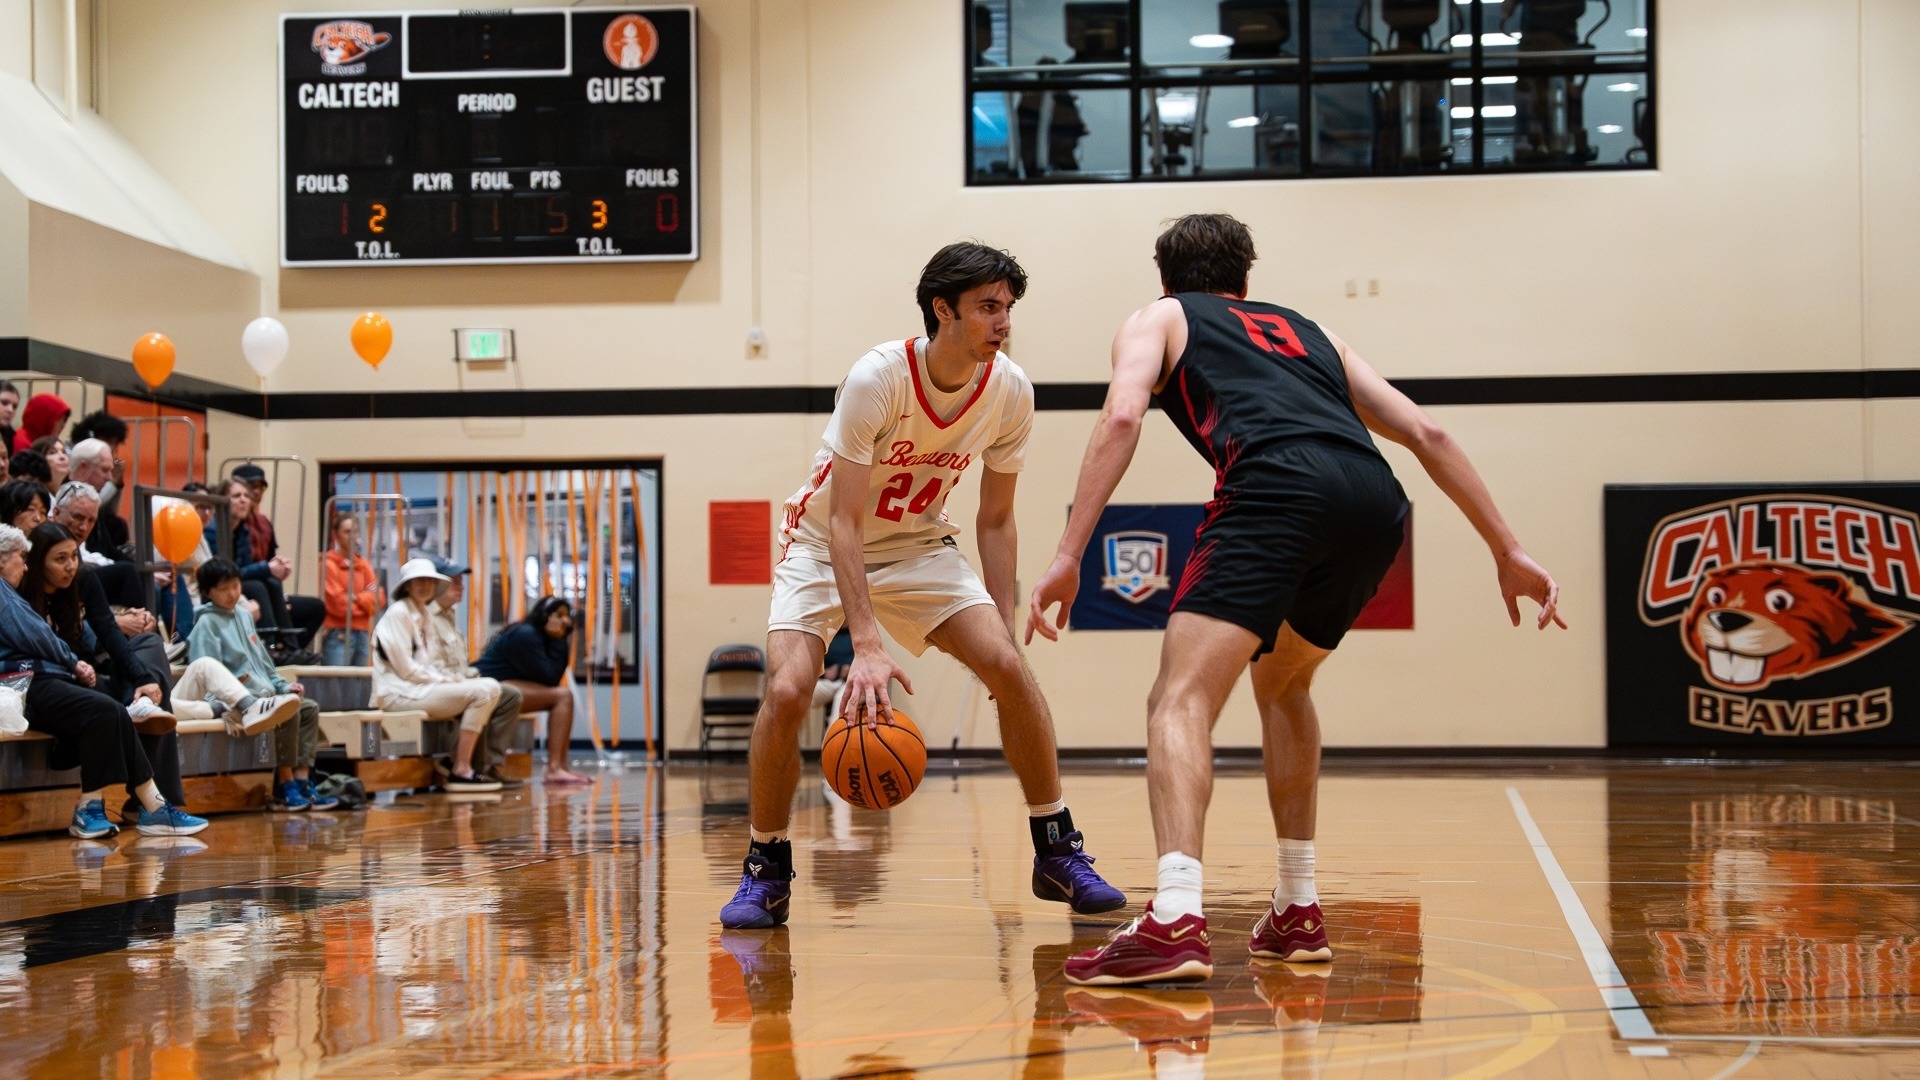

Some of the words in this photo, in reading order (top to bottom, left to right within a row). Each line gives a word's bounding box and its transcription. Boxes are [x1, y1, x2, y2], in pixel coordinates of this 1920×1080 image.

[299, 82, 400, 109] CALTECH
[458, 93, 517, 113] PERIOD
[586, 76, 666, 104] GUEST
[296, 174, 349, 193] FOULS
[413, 172, 454, 191] PLYR
[471, 171, 513, 190] FOUL
[530, 170, 562, 189] PTS
[625, 168, 680, 188] FOULS
[368, 203, 388, 234] 2
[591, 200, 609, 230] 3
[655, 193, 680, 233] 0
[355, 241, 400, 259] T.O.L.
[576, 237, 622, 256] T.O.L.
[1227, 306, 1309, 358] 13
[879, 440, 971, 472] Beavers
[875, 472, 943, 522] 24
[1119, 549, 1153, 573] 50
[1646, 502, 1920, 608] CALTECH
[1690, 687, 1891, 735] BEAVERS
